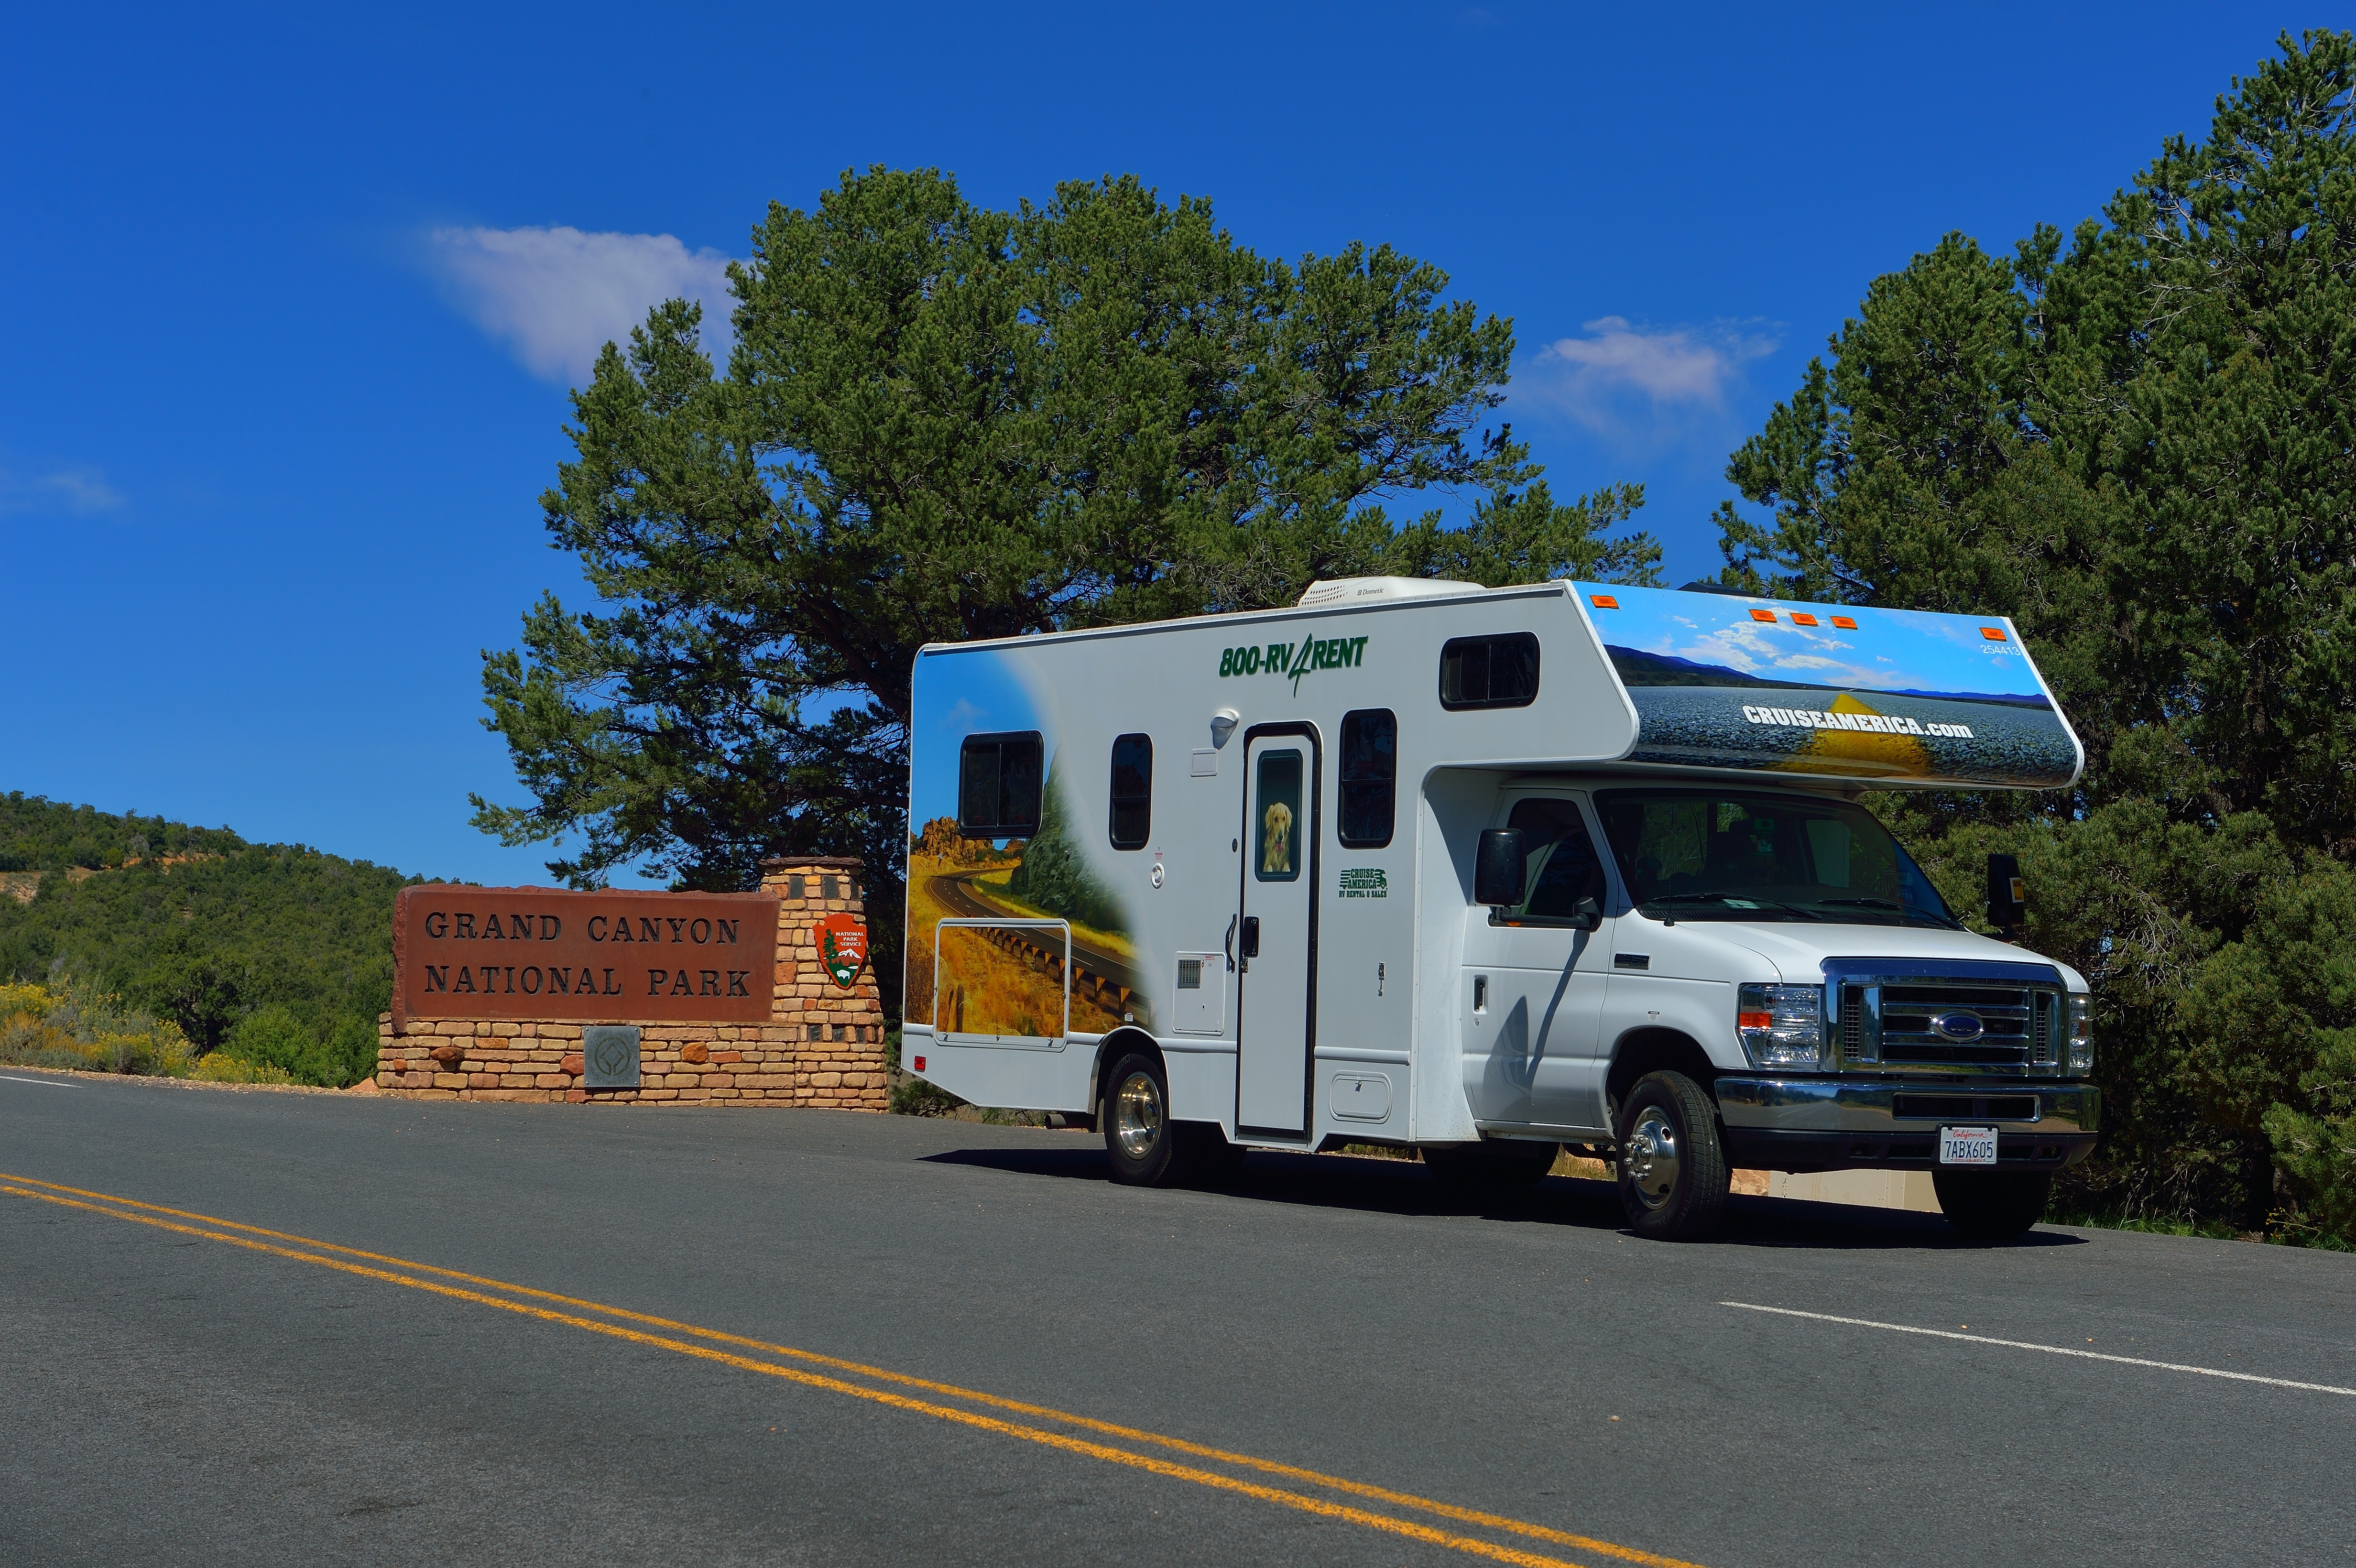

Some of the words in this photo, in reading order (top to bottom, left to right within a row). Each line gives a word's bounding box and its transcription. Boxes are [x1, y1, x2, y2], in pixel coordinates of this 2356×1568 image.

[1980, 644, 2021, 656] 254413
[1742, 705, 1974, 739] CRUISEAMERICA.com
[1351, 868, 1374, 879] CRUISE
[1348, 879, 1377, 889] AMERICA
[425, 912, 561, 941] GRAND
[588, 915, 739, 944] CANYON
[425, 965, 622, 995] NATIONAL
[647, 969, 751, 997] PARK
[586, 1042, 595, 1059] Grand
[589, 1065, 602, 1081] World
[602, 1076, 628, 1085] Heritage
[627, 1066, 637, 1077] Site
[1953, 1129, 1987, 1140] California
[1945, 1141, 1993, 1158] 7ABX605
